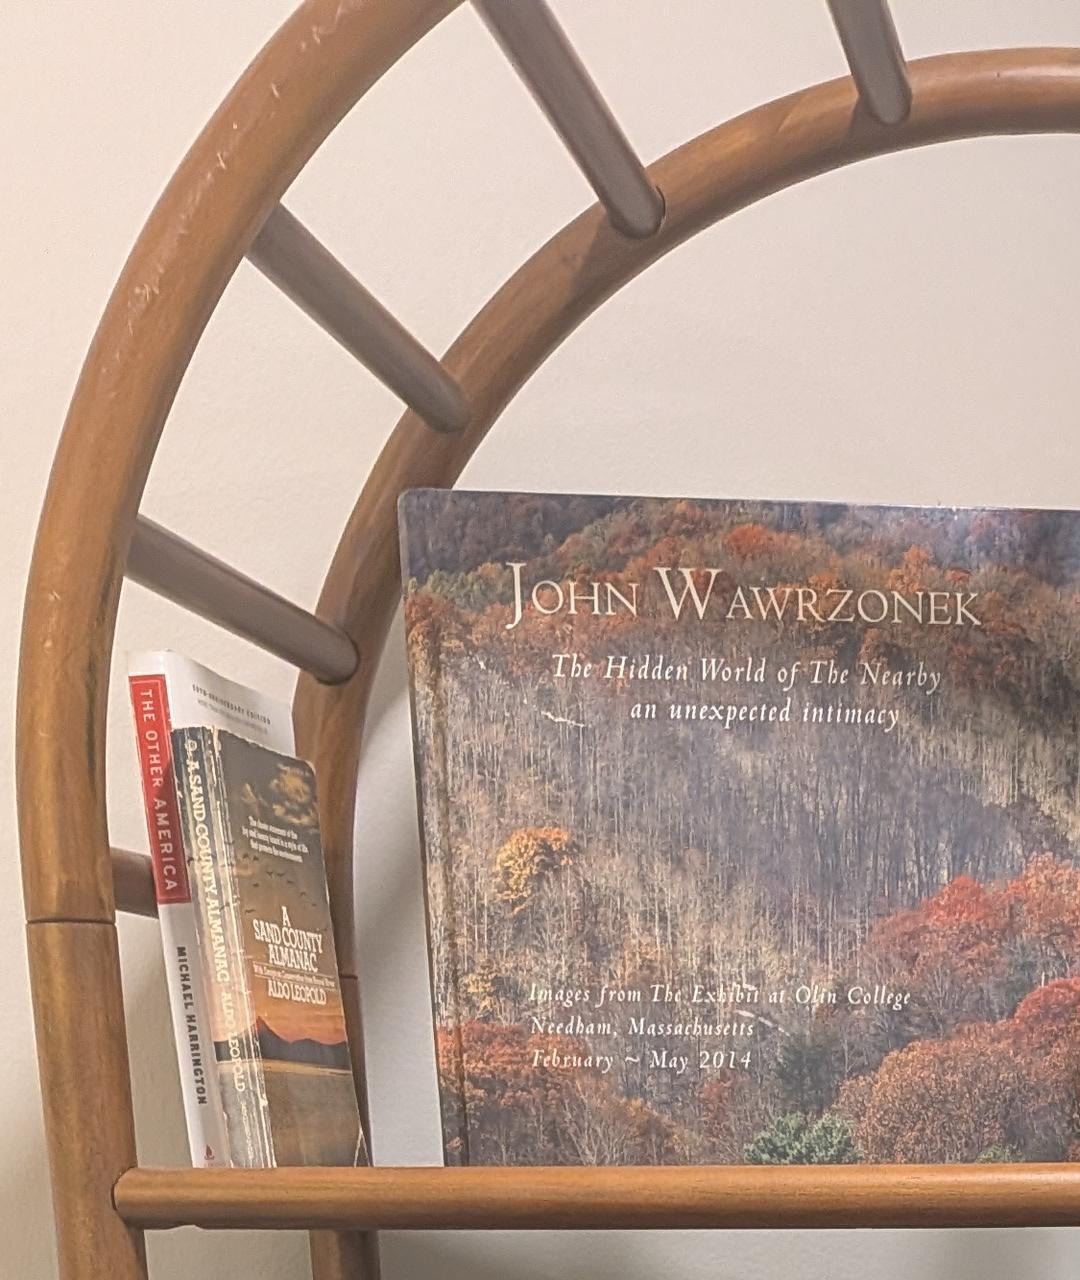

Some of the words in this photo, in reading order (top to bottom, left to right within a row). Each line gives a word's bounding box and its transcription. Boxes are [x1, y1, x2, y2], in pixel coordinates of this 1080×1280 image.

[505, 561, 640, 631] JOHN
[653, 565, 982, 628] WAWRZONEK
[552, 653, 594, 681] The
[604, 657, 688, 683] Hidden
[700, 658, 768, 686] World
[778, 660, 803, 690] of
[808, 660, 852, 687] The
[860, 664, 942, 694] Nearby
[140, 689, 154, 721] THE
[629, 702, 656, 720] an
[668, 700, 791, 726] unexpected
[802, 699, 899, 731] intimacy
[145, 729, 163, 788] OTHER
[155, 798, 177, 892] AMERICA
[282, 906, 291, 928] A
[254, 921, 282, 942] SAND
[281, 928, 322, 953] COUNTY
[268, 945, 318, 972] ALMANAC
[268, 981, 291, 999] ALDO
[292, 984, 327, 1005] LEOPOLD
[529, 985, 591, 1008] Images
[598, 985, 643, 1008] from
[650, 986, 685, 1005] The
[692, 987, 761, 1006] Exhibit
[769, 991, 788, 1007] at
[795, 988, 838, 1007] Olin
[847, 986, 912, 1010] College
[176, 946, 194, 1010] MICHAEL
[186, 1014, 207, 1106] HARRINGTON
[530, 1018, 619, 1038] Needham,
[627, 1018, 755, 1038] Massachusetts
[532, 1050, 614, 1072] February
[650, 1051, 691, 1072] May
[699, 1051, 752, 1070] 2014
